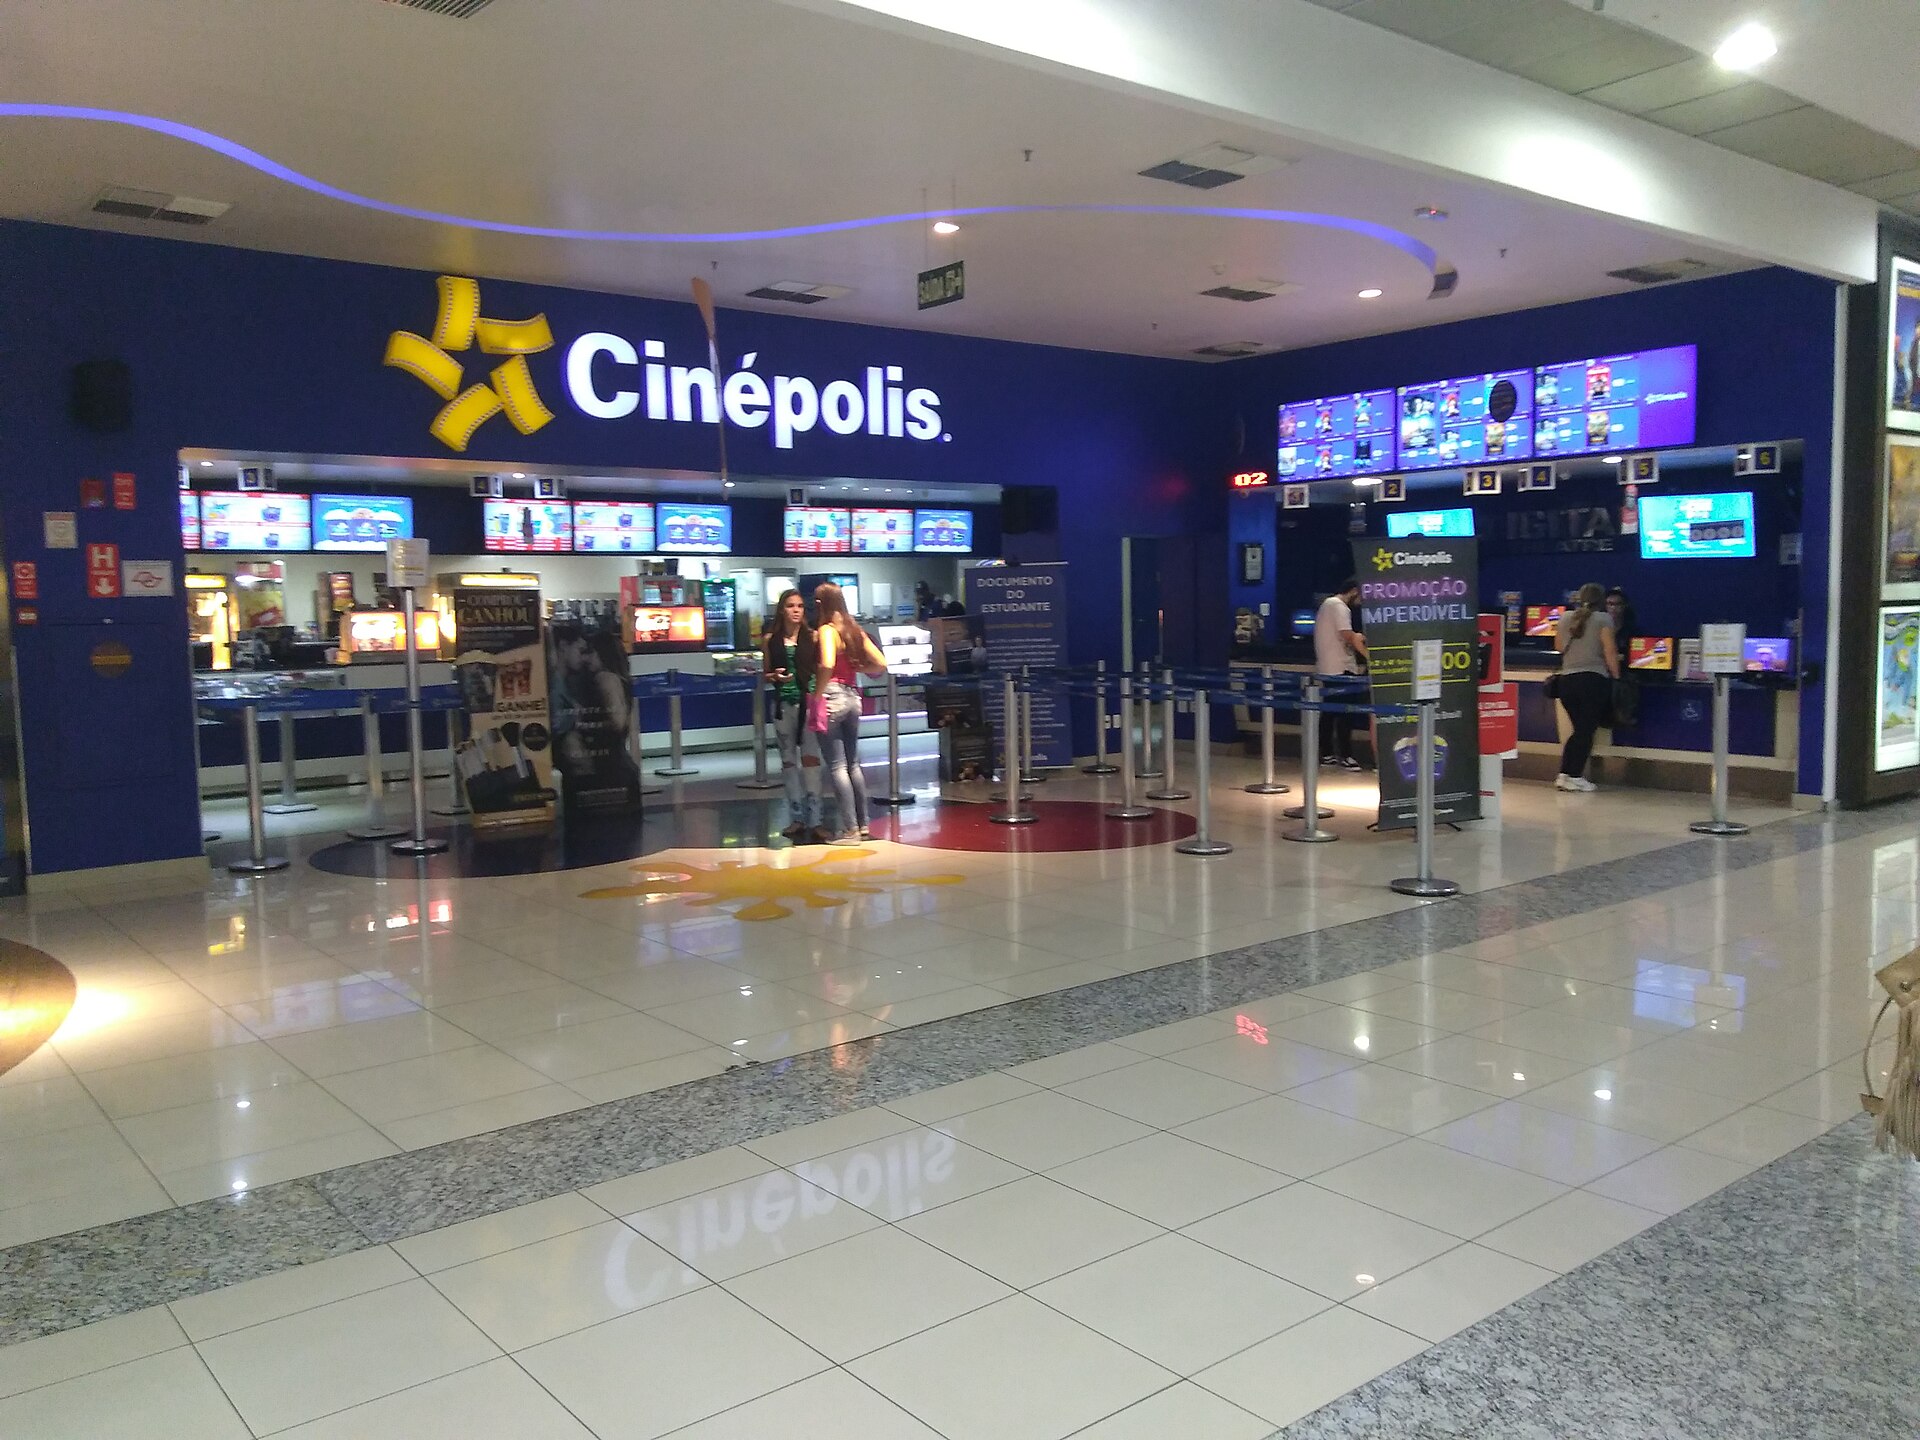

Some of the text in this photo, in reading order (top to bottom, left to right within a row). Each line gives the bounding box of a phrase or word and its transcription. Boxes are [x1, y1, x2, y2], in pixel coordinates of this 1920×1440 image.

[565, 332, 945, 449] Cinépolis
[1536, 470, 1547, 482] 4
[1638, 462, 1649, 476] 5
[1483, 474, 1493, 488] 3
[1387, 483, 1399, 496] 2
[92, 546, 114, 568] H
[1393, 551, 1453, 567] Cinépolis
[976, 576, 1054, 588] DOCUMENTO
[1361, 576, 1468, 600] PROMOÇÃO
[1006, 589, 1026, 599] DO
[981, 601, 1052, 613] ESTUDANTE
